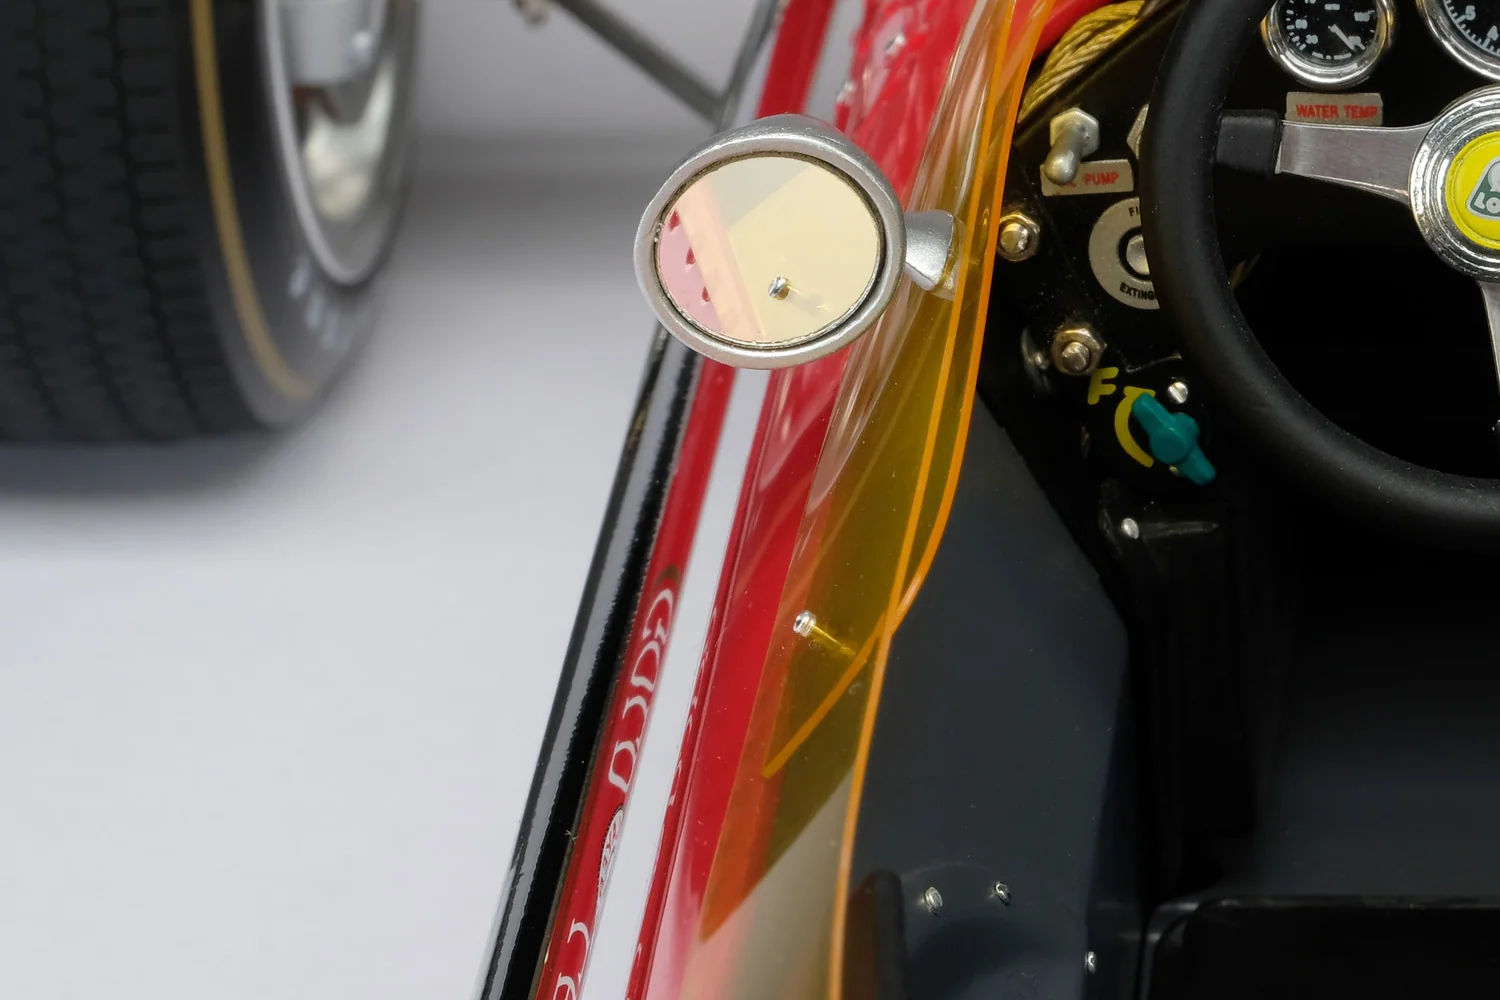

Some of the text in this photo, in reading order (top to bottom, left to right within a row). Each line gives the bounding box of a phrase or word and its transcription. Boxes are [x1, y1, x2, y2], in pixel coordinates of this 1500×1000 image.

[1465, 5, 1476, 20] 5
[1487, 25, 1499, 40] 4
[1295, 103, 1379, 119] WATER TEMP
[1083, 171, 1119, 185] PUMP
